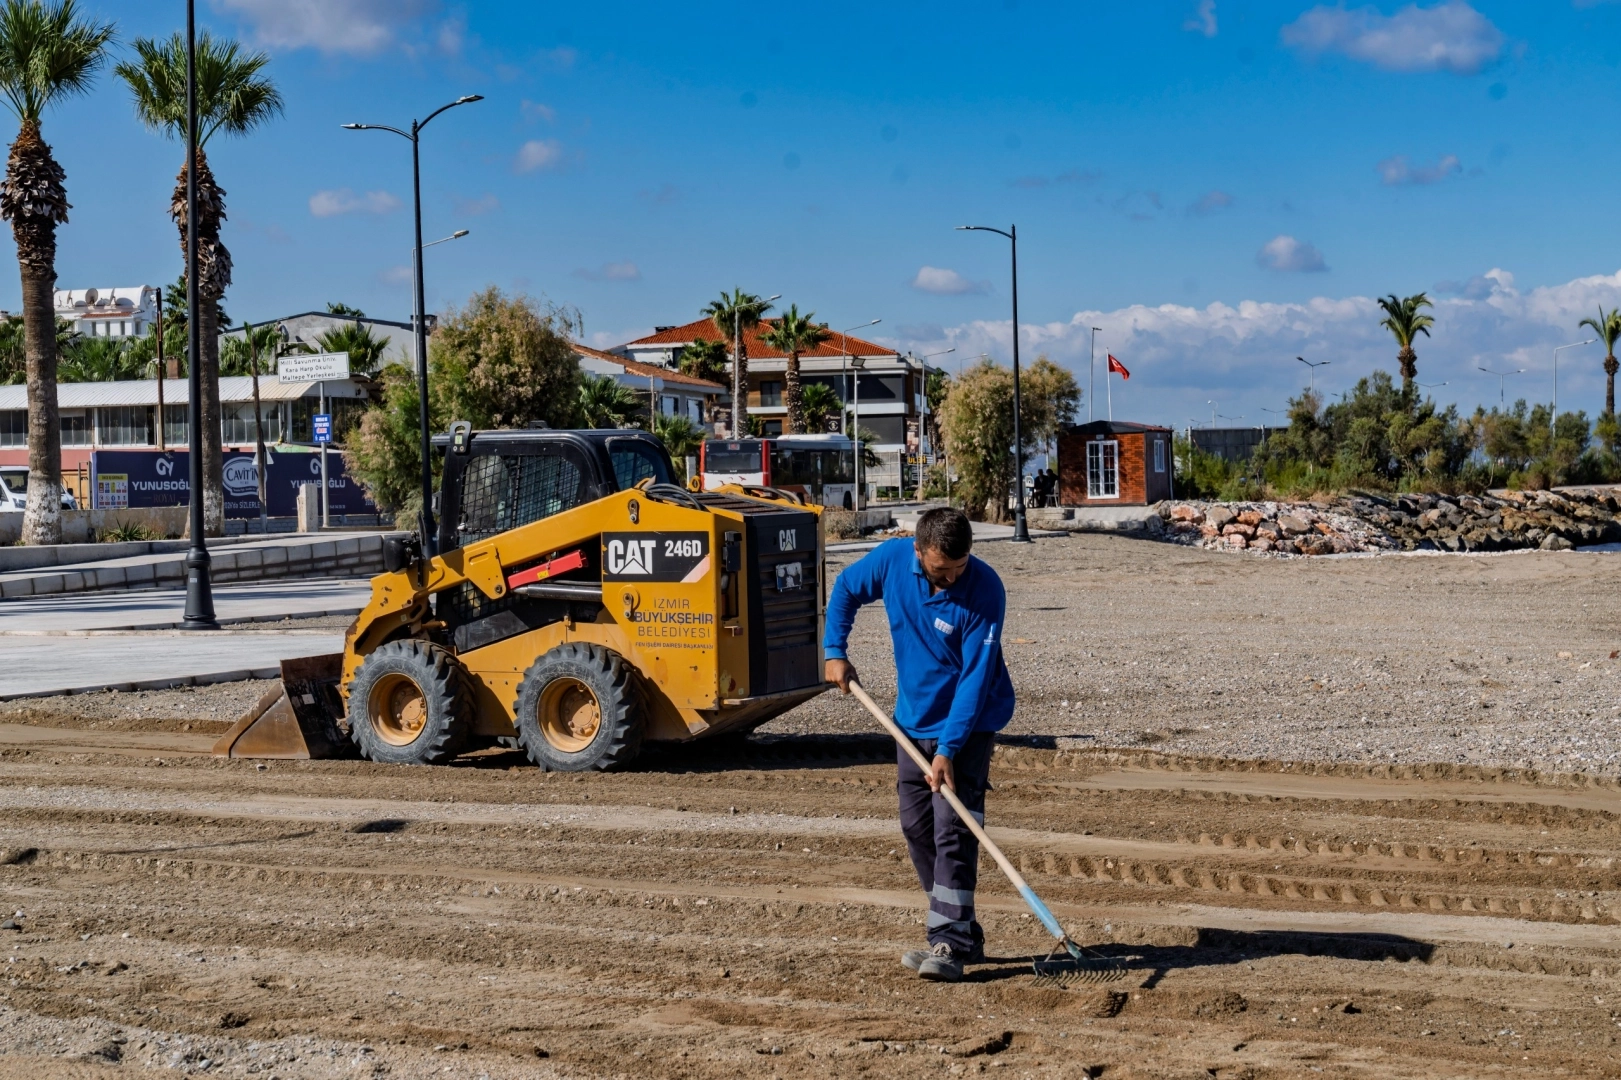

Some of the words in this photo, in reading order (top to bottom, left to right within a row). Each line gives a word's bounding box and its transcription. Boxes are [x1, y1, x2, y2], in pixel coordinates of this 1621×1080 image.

[132, 479, 190, 491] YUNUSOĞL
[290, 478, 346, 489] YUSĞLU
[779, 528, 796, 551] CAT
[608, 540, 656, 574] CAT
[665, 540, 702, 557] 246D
[653, 597, 690, 609] İZMİR
[634, 609, 714, 625] BÜYÜKŞEHİR
[638, 625, 711, 638] BELEDİYESİ
